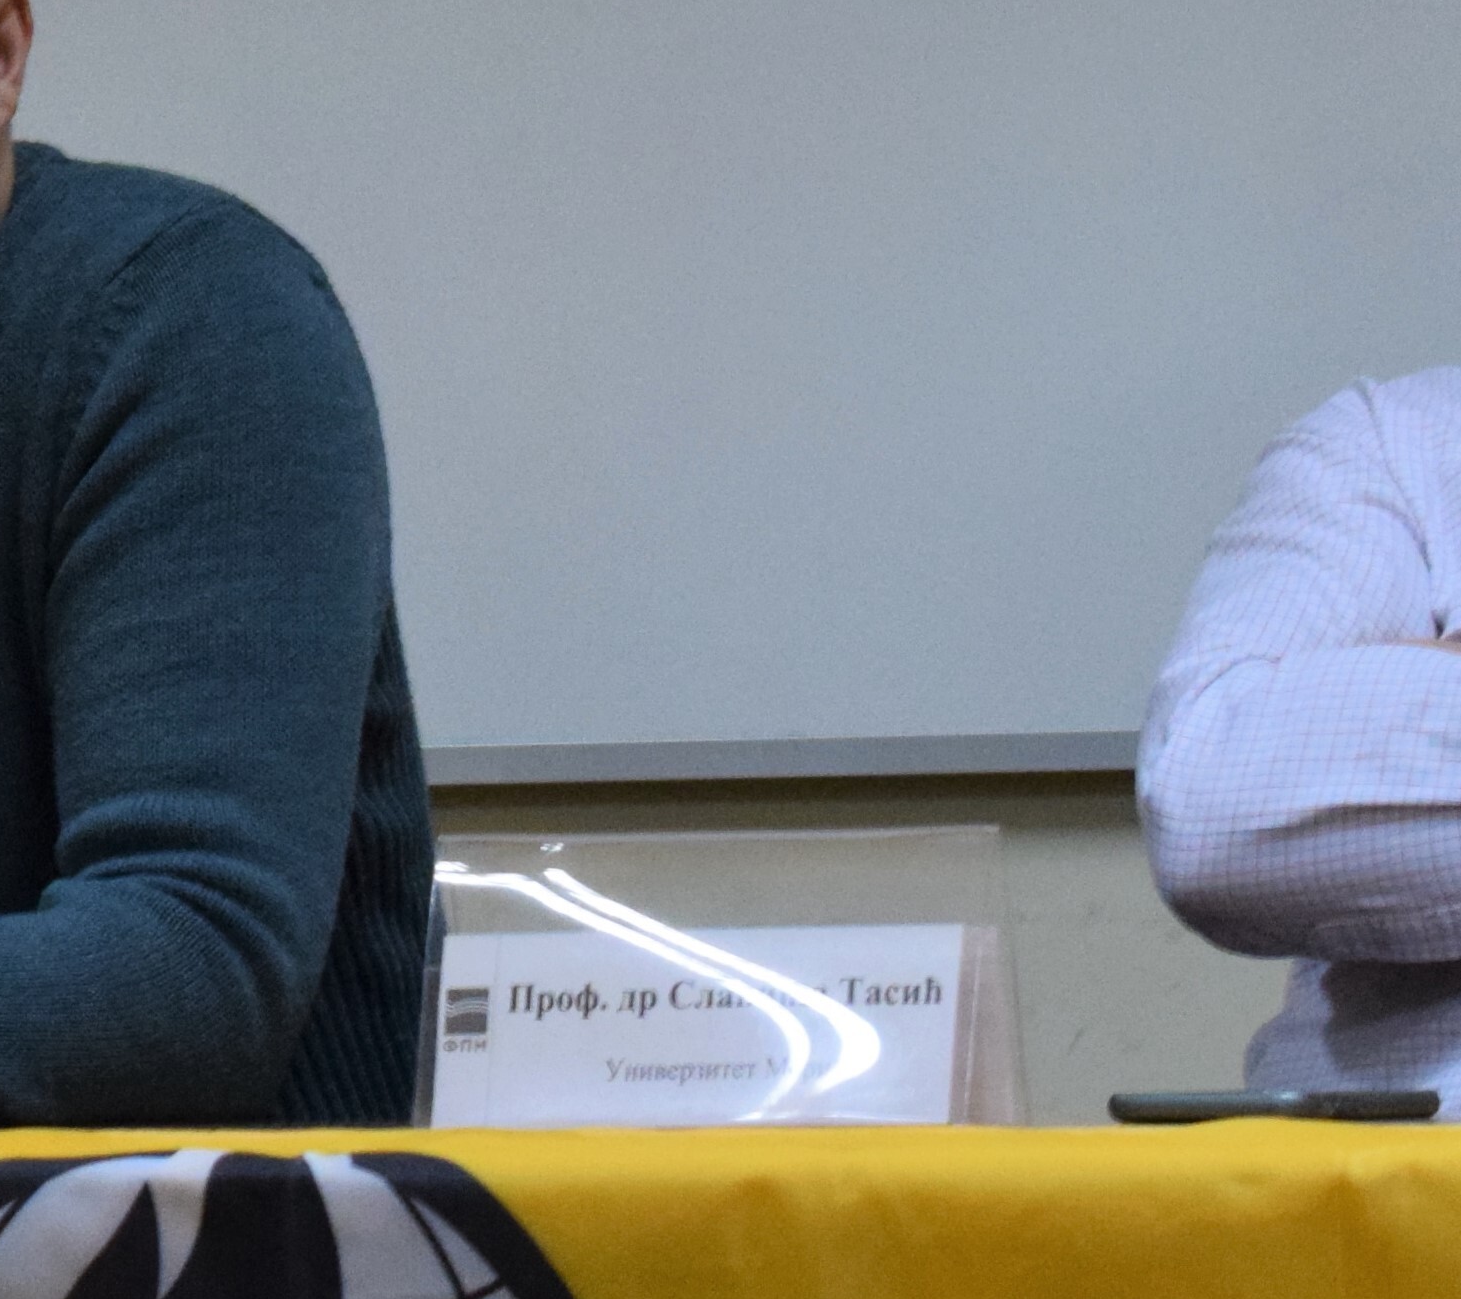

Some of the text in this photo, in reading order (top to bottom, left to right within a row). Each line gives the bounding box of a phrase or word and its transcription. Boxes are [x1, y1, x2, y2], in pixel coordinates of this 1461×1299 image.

[508, 981, 607, 1020] Проф.
[616, 988, 658, 1019] др
[839, 975, 943, 1006] Тасић
